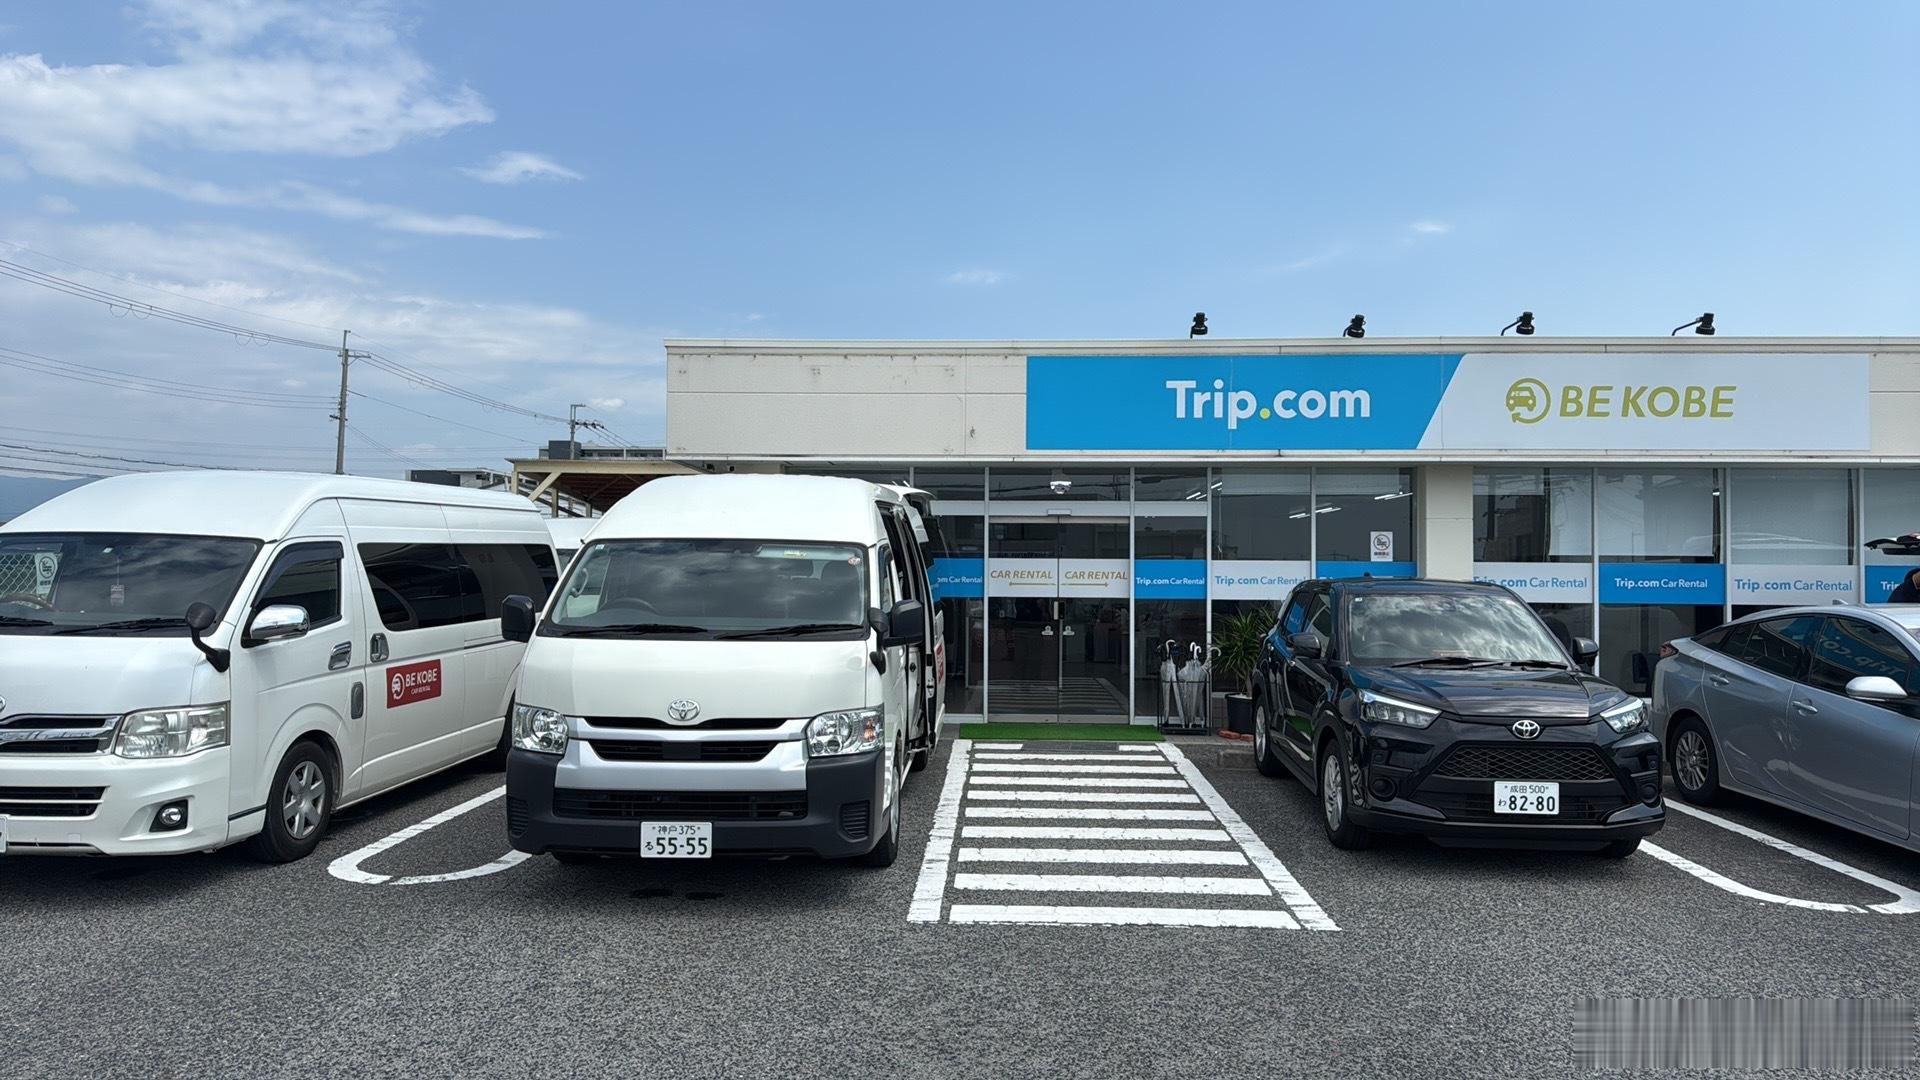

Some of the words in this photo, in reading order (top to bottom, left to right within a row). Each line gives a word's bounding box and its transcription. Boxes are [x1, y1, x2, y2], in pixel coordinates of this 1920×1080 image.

[1166, 379, 1370, 429] Trip.com
[1560, 386, 1613, 417] BE
[1621, 386, 1736, 417] KOBE
[991, 570, 1010, 579] CAR
[1012, 570, 1053, 579] RENTAL
[1065, 571, 1085, 580] CAR
[1087, 571, 1128, 580] RENTAL
[1136, 577, 1169, 586] Trip.com
[1170, 577, 1183, 585] Car
[1183, 577, 1205, 585] Rental
[1215, 575, 1259, 586] Trip.com
[1260, 576, 1277, 585] Car
[1530, 577, 1549, 588] Car
[1551, 577, 1587, 588] Rental
[1614, 577, 1660, 588] Trip.com
[1661, 578, 1678, 588] Car
[1679, 577, 1708, 588] Rental
[1734, 578, 1791, 591] Trip.com
[1793, 580, 1814, 591] Car
[1815, 580, 1852, 591] Rental
[405, 672, 416, 687] BE
[416, 668, 438, 685] KOBE
[1528, 785, 1546, 794] 500
[1508, 795, 1556, 812] 82-80
[657, 825, 678, 835] 神戸
[678, 825, 696, 835] 375
[645, 841, 654, 851] る
[656, 837, 708, 855] 55-55
